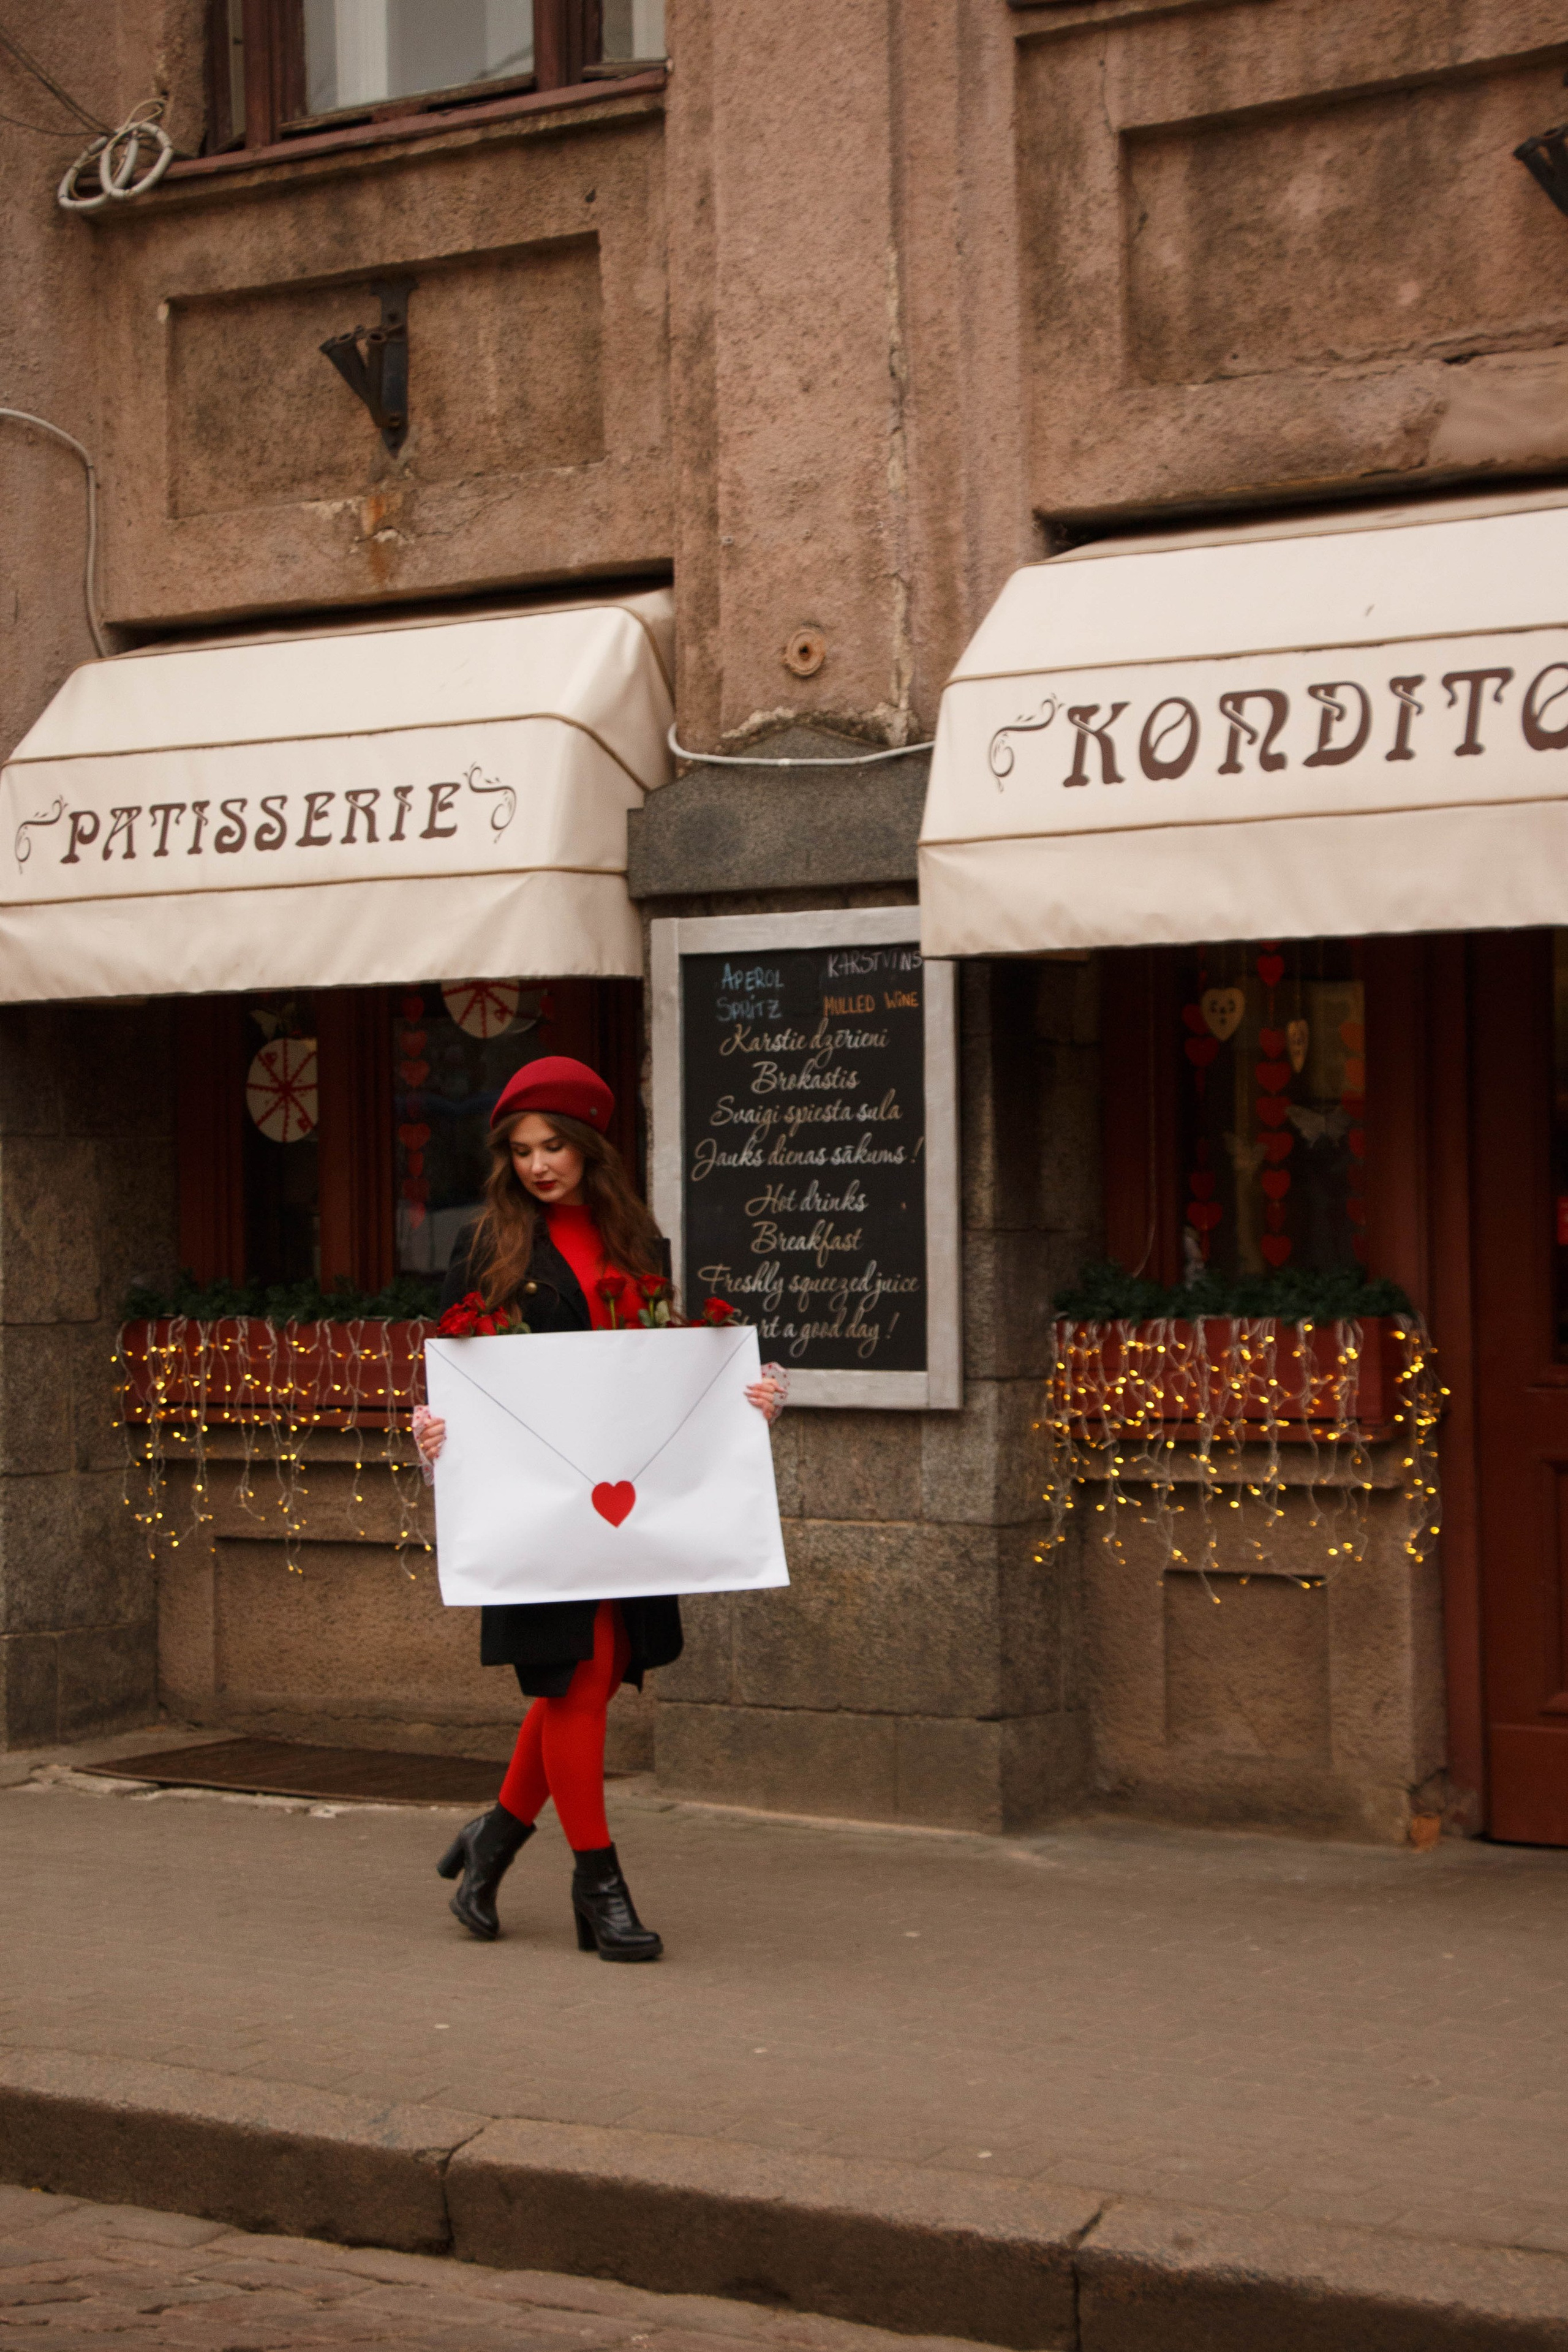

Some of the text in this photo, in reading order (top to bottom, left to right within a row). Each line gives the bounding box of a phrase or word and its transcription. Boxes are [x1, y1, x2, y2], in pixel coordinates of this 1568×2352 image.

[1063, 662, 1568, 788] KONDITO
[59, 782, 462, 865] PATISSERIE
[721, 962, 785, 992] APEROL
[823, 994, 875, 1017] MULLED
[719, 1016, 889, 1069] Karstie dzērieni
[750, 1058, 861, 1094] Brokastis
[709, 1088, 903, 1143] Svaigi spiesta sula
[691, 1134, 764, 1181] Jauks
[768, 1133, 829, 1166] dienas
[745, 1179, 869, 1216] Hot drinks
[750, 1219, 863, 1268] Breakfast
[697, 1259, 919, 1313] Freshly squeezed juice
[782, 1322, 799, 1338] a
[790, 1306, 845, 1359] good
